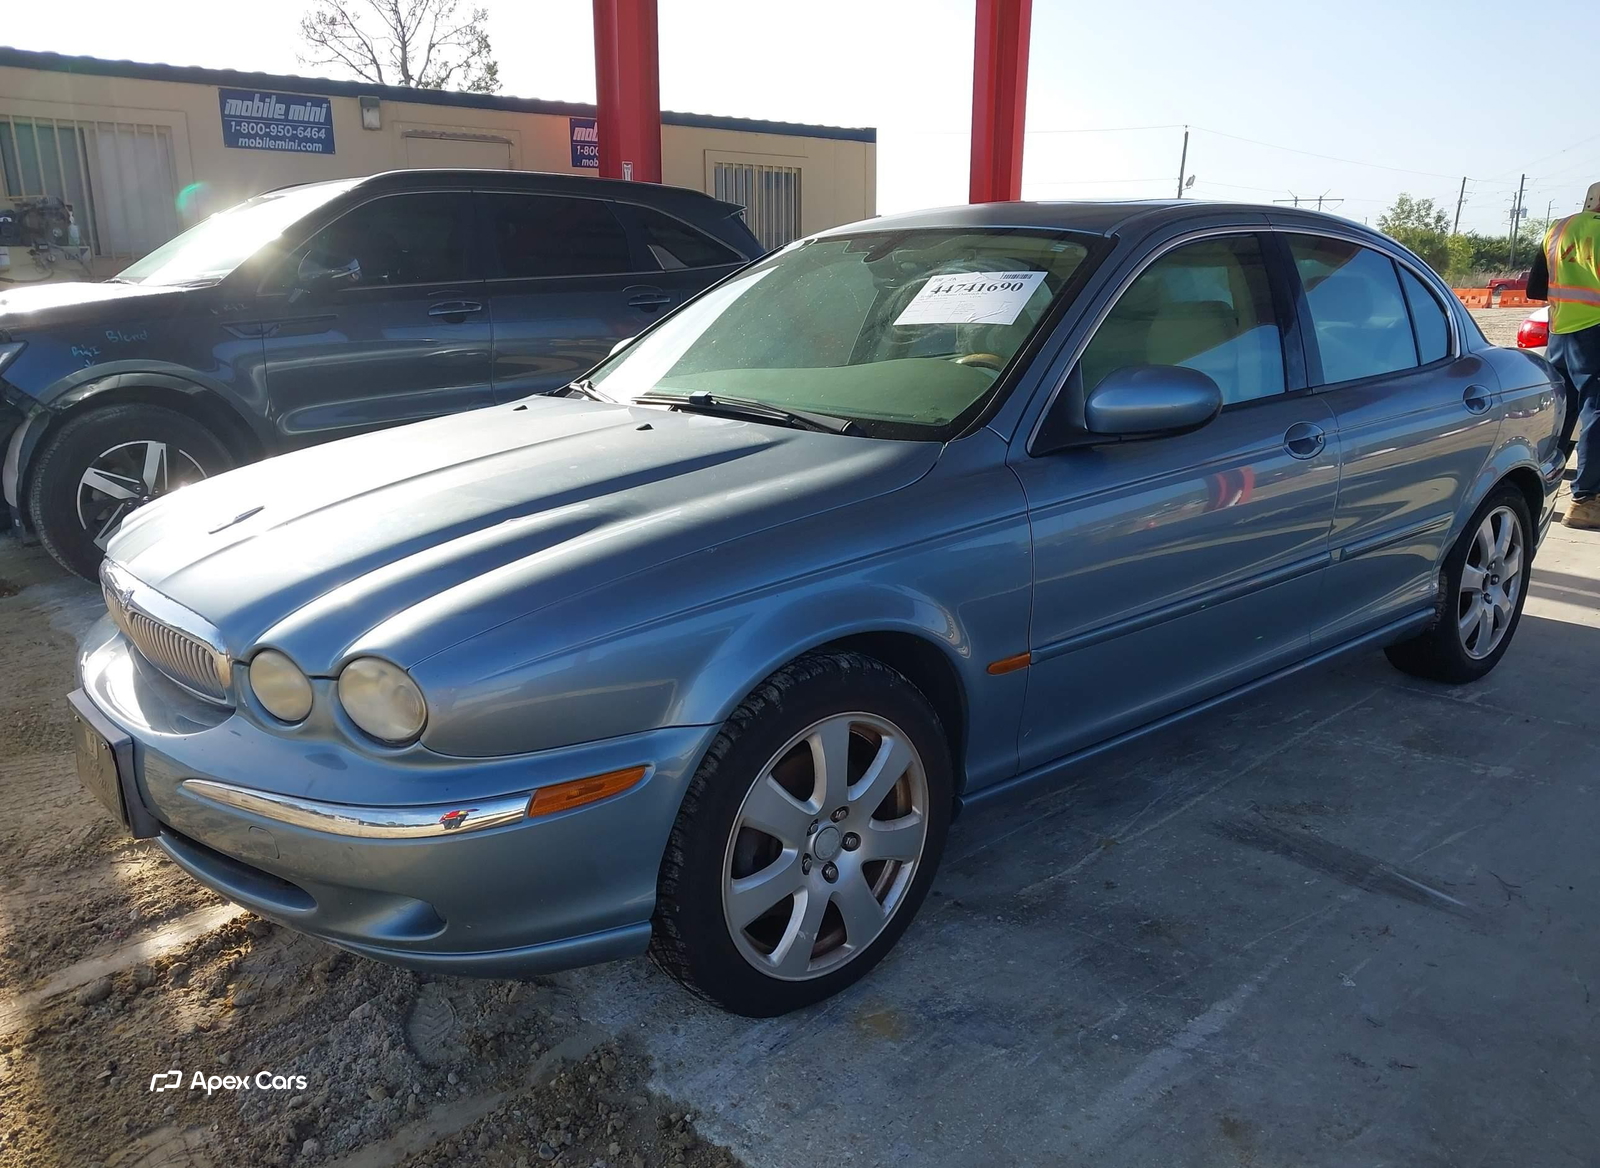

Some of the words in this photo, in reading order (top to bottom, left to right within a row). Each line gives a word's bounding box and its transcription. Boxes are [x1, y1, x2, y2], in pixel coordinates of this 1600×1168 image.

[224, 93, 286, 119] mobile
[288, 101, 328, 123] mini
[230, 121, 326, 139] 1-800-950-6464
[238, 136, 323, 152] mobilemini.com
[930, 281, 1024, 295] 44741690
